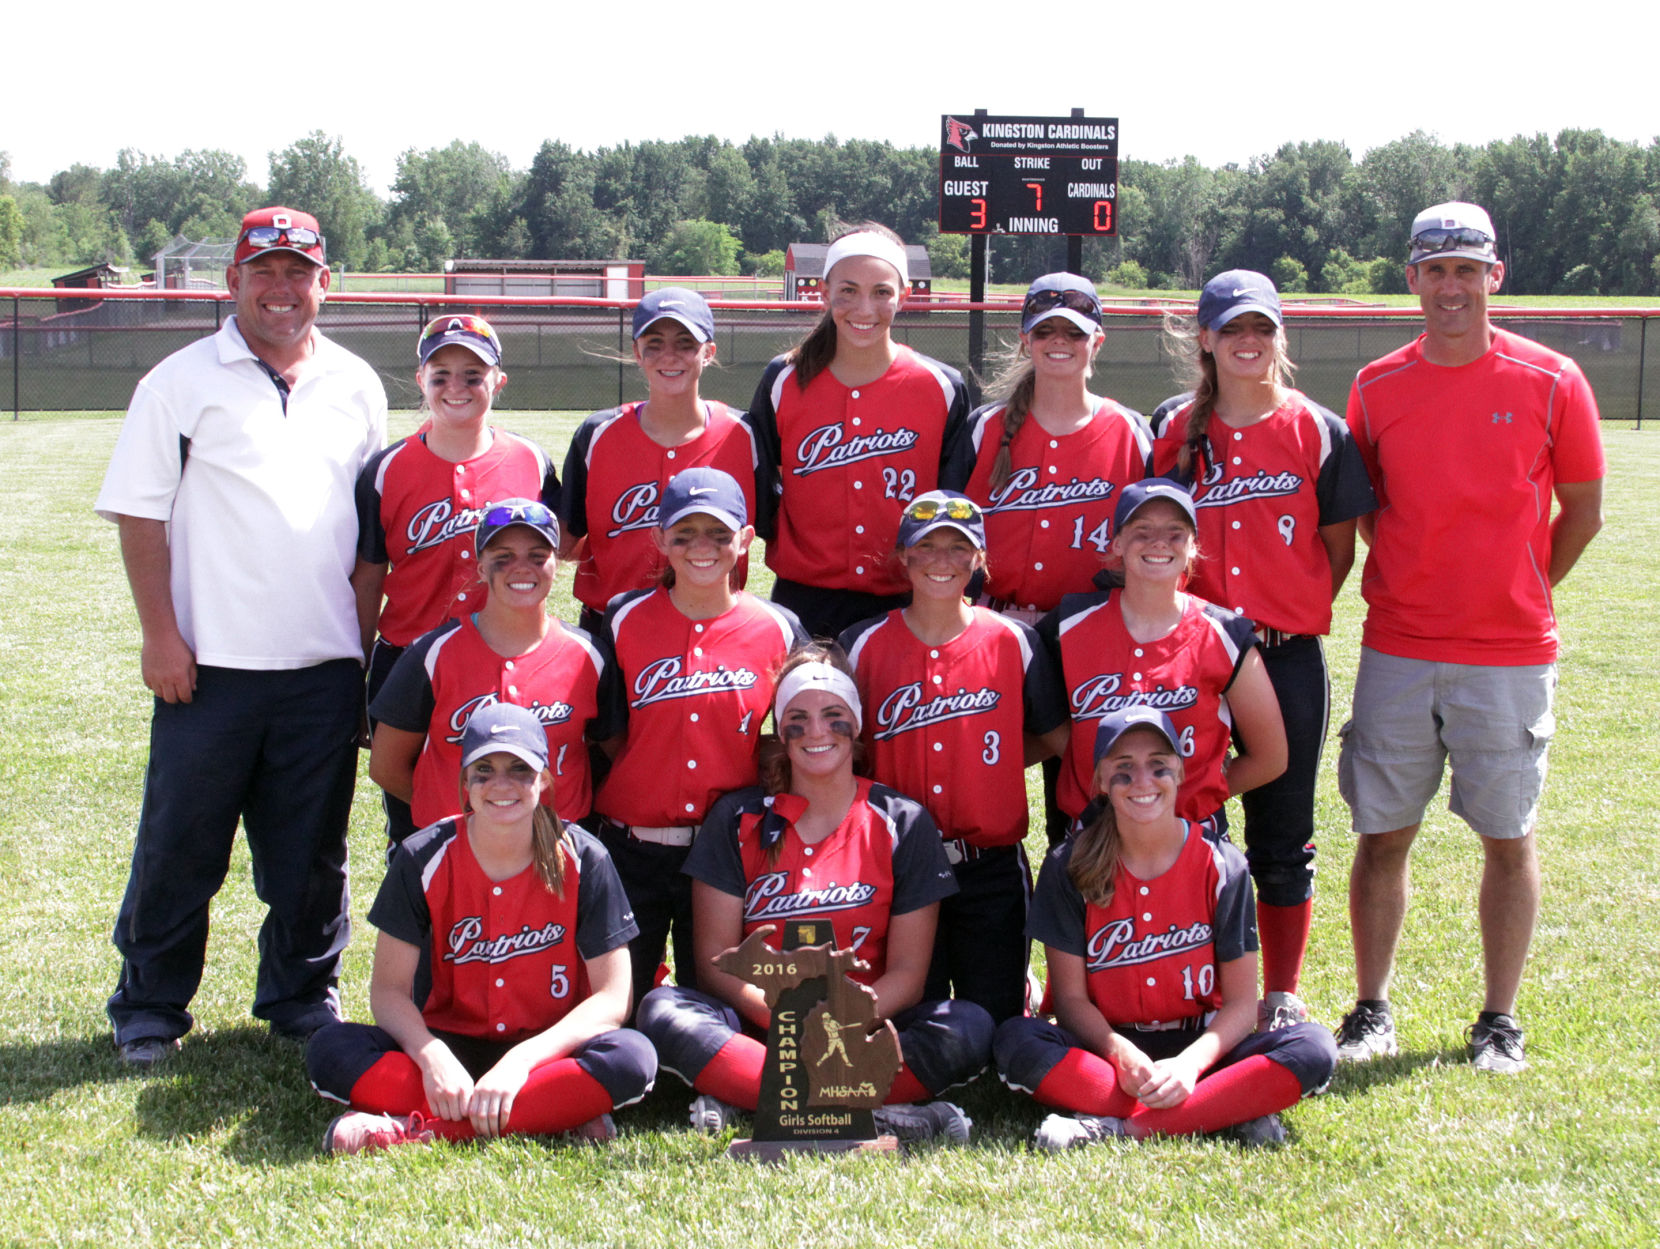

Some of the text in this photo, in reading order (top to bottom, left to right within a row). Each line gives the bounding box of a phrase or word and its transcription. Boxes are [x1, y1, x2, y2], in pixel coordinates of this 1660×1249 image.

[982, 123, 1115, 140] KINGSTON CARDINALS
[1027, 142, 1055, 150] Kingston
[954, 156, 979, 168] BALL
[1014, 157, 1050, 169] STRIKE
[1081, 158, 1103, 170] OUT
[944, 181, 989, 196] GUEST
[1026, 183, 1043, 212] 7
[1067, 183, 1116, 198] CARDINALS
[970, 198, 987, 229] 3
[1008, 217, 1059, 233] INNING
[1093, 201, 1112, 231] 0
[793, 422, 919, 477] Patriots
[882, 466, 916, 501] 22
[982, 467, 1115, 515] Patriots
[1069, 514, 1111, 552] 14
[631, 655, 758, 710] Patriots
[1071, 673, 1198, 723] Patriots
[873, 681, 1001, 741] Patriots
[982, 730, 1001, 765] 3
[1180, 725, 1195, 758] 6
[744, 870, 877, 923] Patriots
[443, 916, 566, 965] Patriots
[851, 926, 872, 955] 7
[1087, 916, 1215, 973] Patriots
[550, 964, 569, 999] 5
[752, 963, 797, 976] 2016
[1181, 963, 1215, 1000] 10
[778, 1011, 798, 1111] CHAMPION
[819, 1085, 868, 1098] MHSAA
[779, 1113, 852, 1127] Girls Softball
